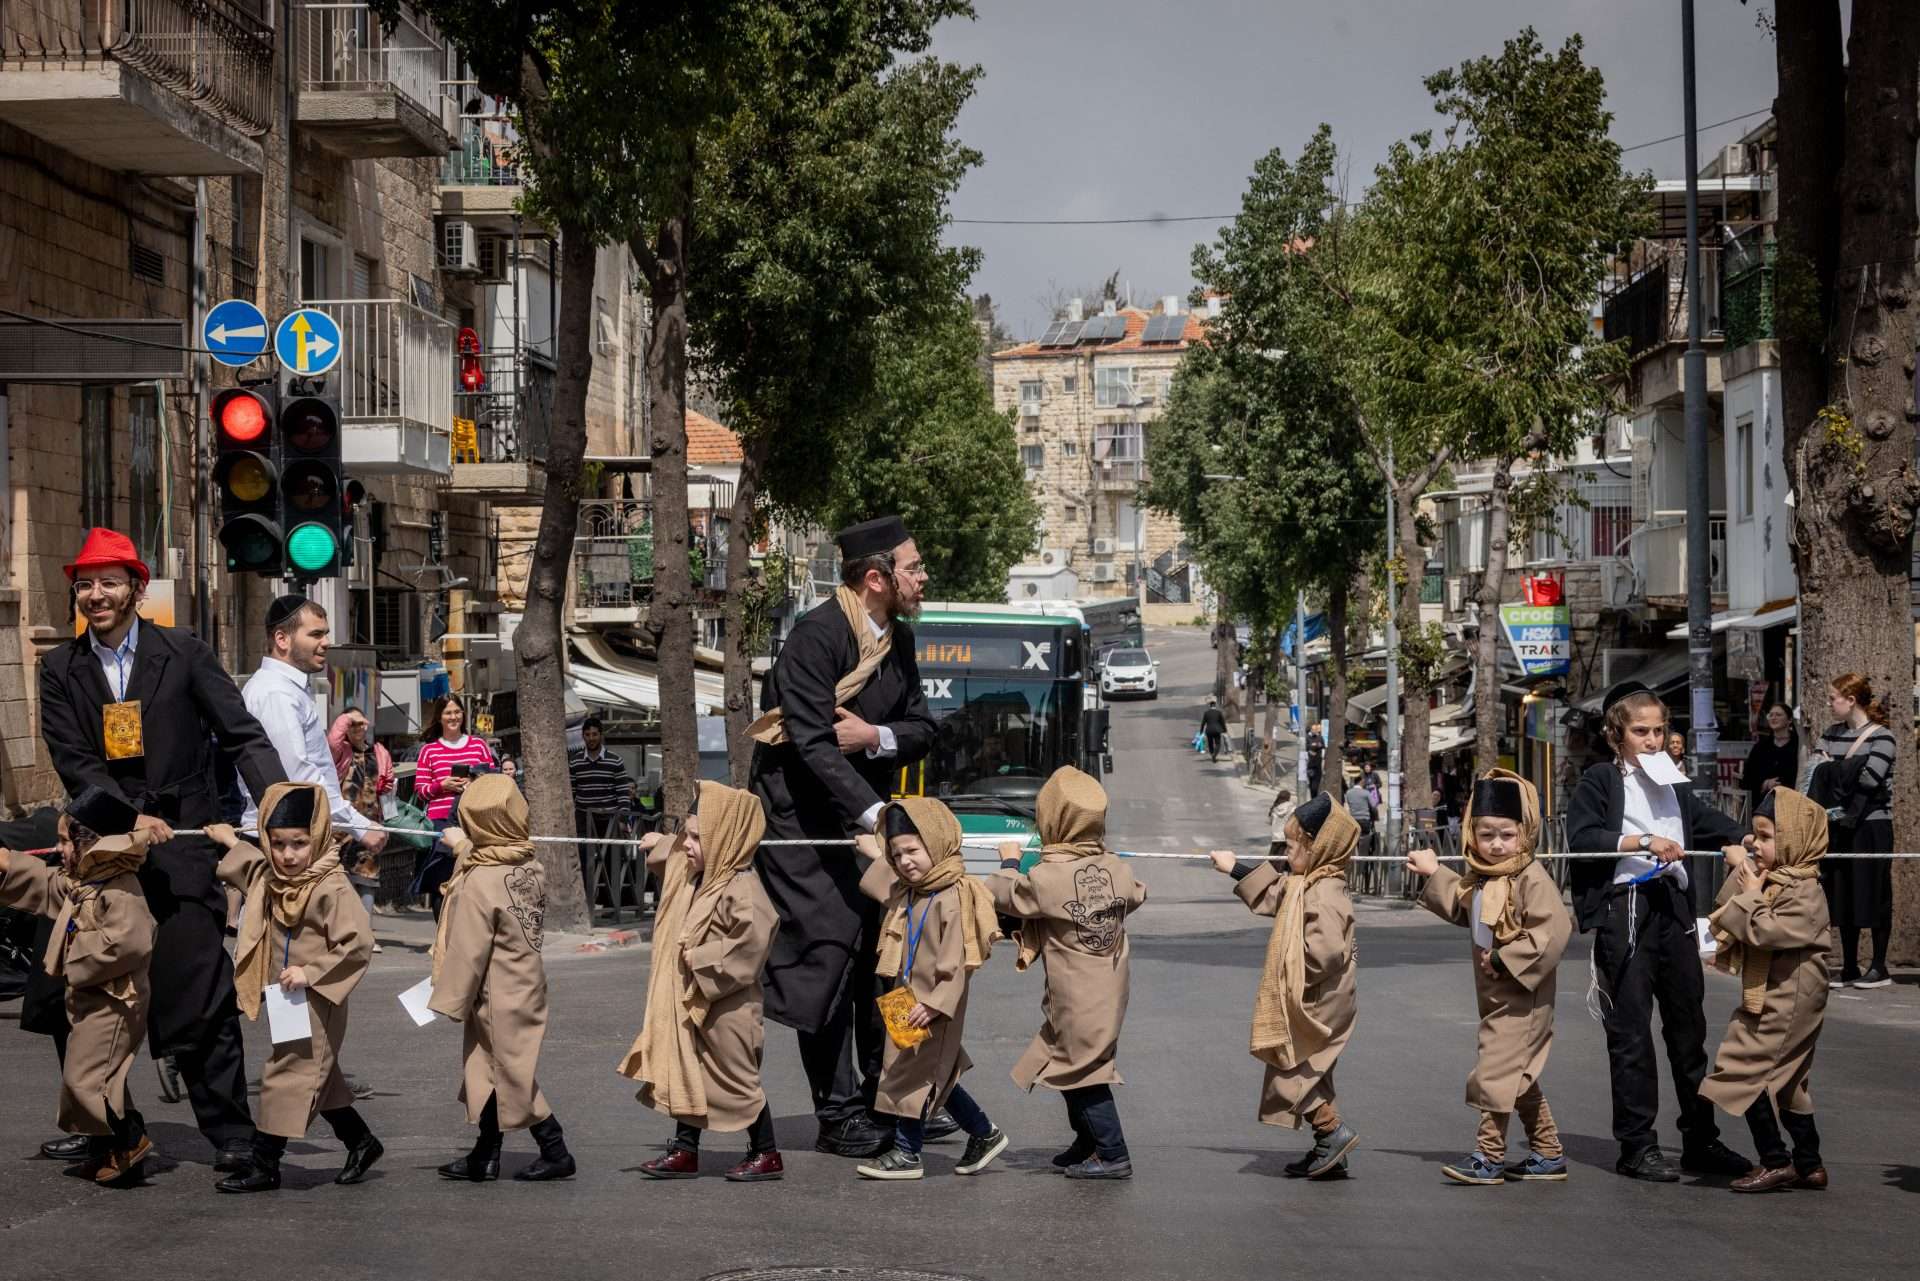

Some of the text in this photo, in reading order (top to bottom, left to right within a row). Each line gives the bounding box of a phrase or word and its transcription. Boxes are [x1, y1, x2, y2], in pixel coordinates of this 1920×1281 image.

[1509, 610, 1564, 622] crocs
[1521, 627, 1561, 641] HOKA
[1519, 645, 1560, 656] TRAK
